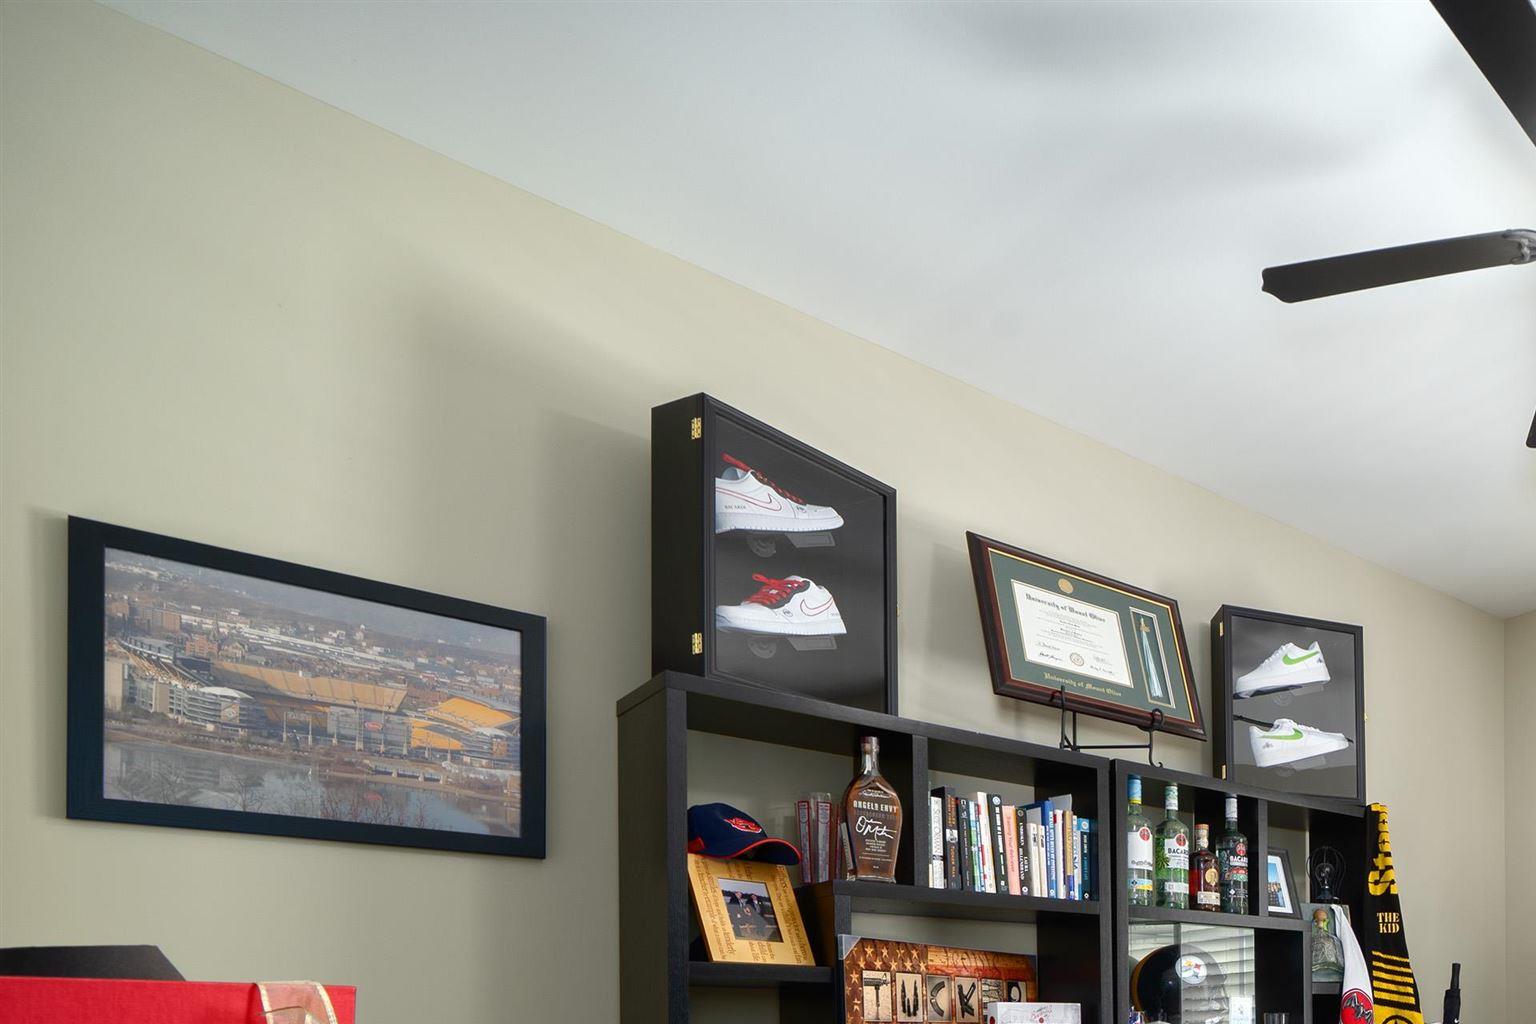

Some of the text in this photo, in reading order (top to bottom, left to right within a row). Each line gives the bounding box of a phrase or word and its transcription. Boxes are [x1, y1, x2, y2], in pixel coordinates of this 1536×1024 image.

[1026, 592, 1060, 610] University
[1044, 672, 1077, 687] University
[1377, 912, 1400, 923] THE
[1379, 923, 1400, 934] KID
